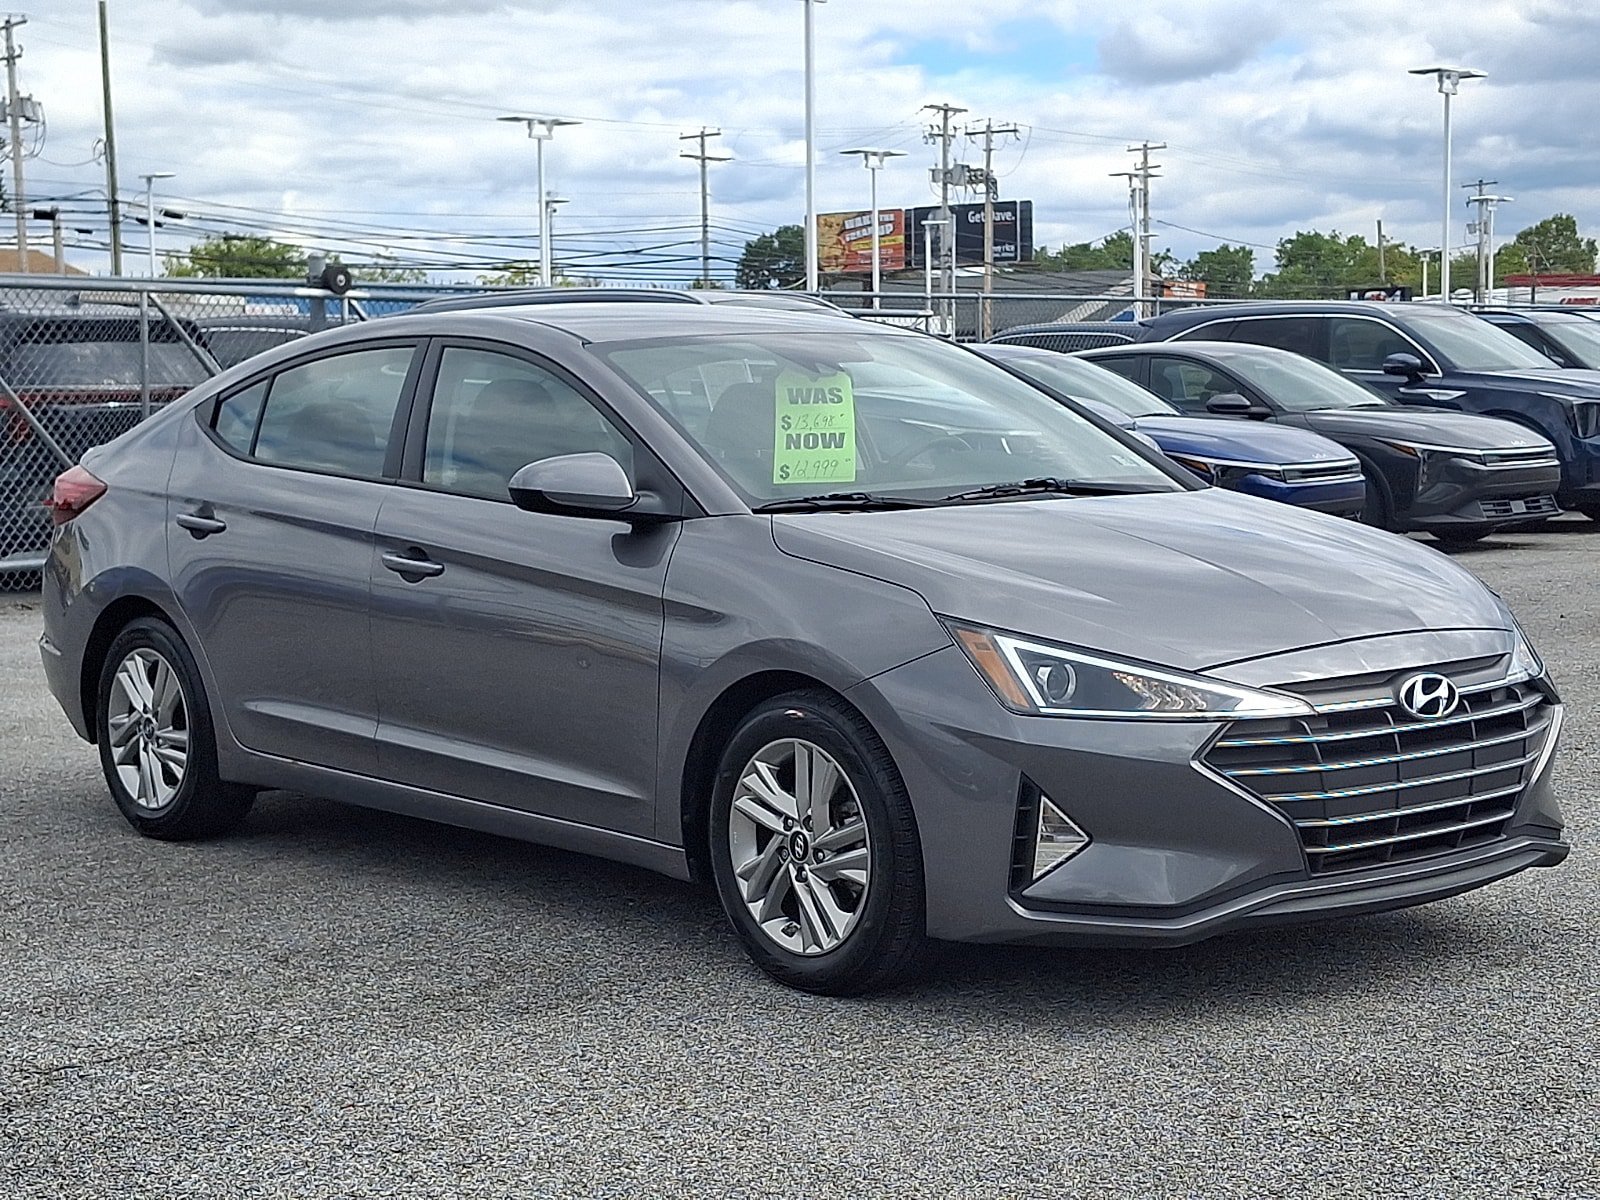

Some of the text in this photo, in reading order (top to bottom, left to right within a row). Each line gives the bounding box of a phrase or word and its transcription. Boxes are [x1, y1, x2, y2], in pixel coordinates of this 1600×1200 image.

[967, 210, 986, 223] Get
[786, 387, 843, 405] WAS
[785, 432, 845, 451] NOW
